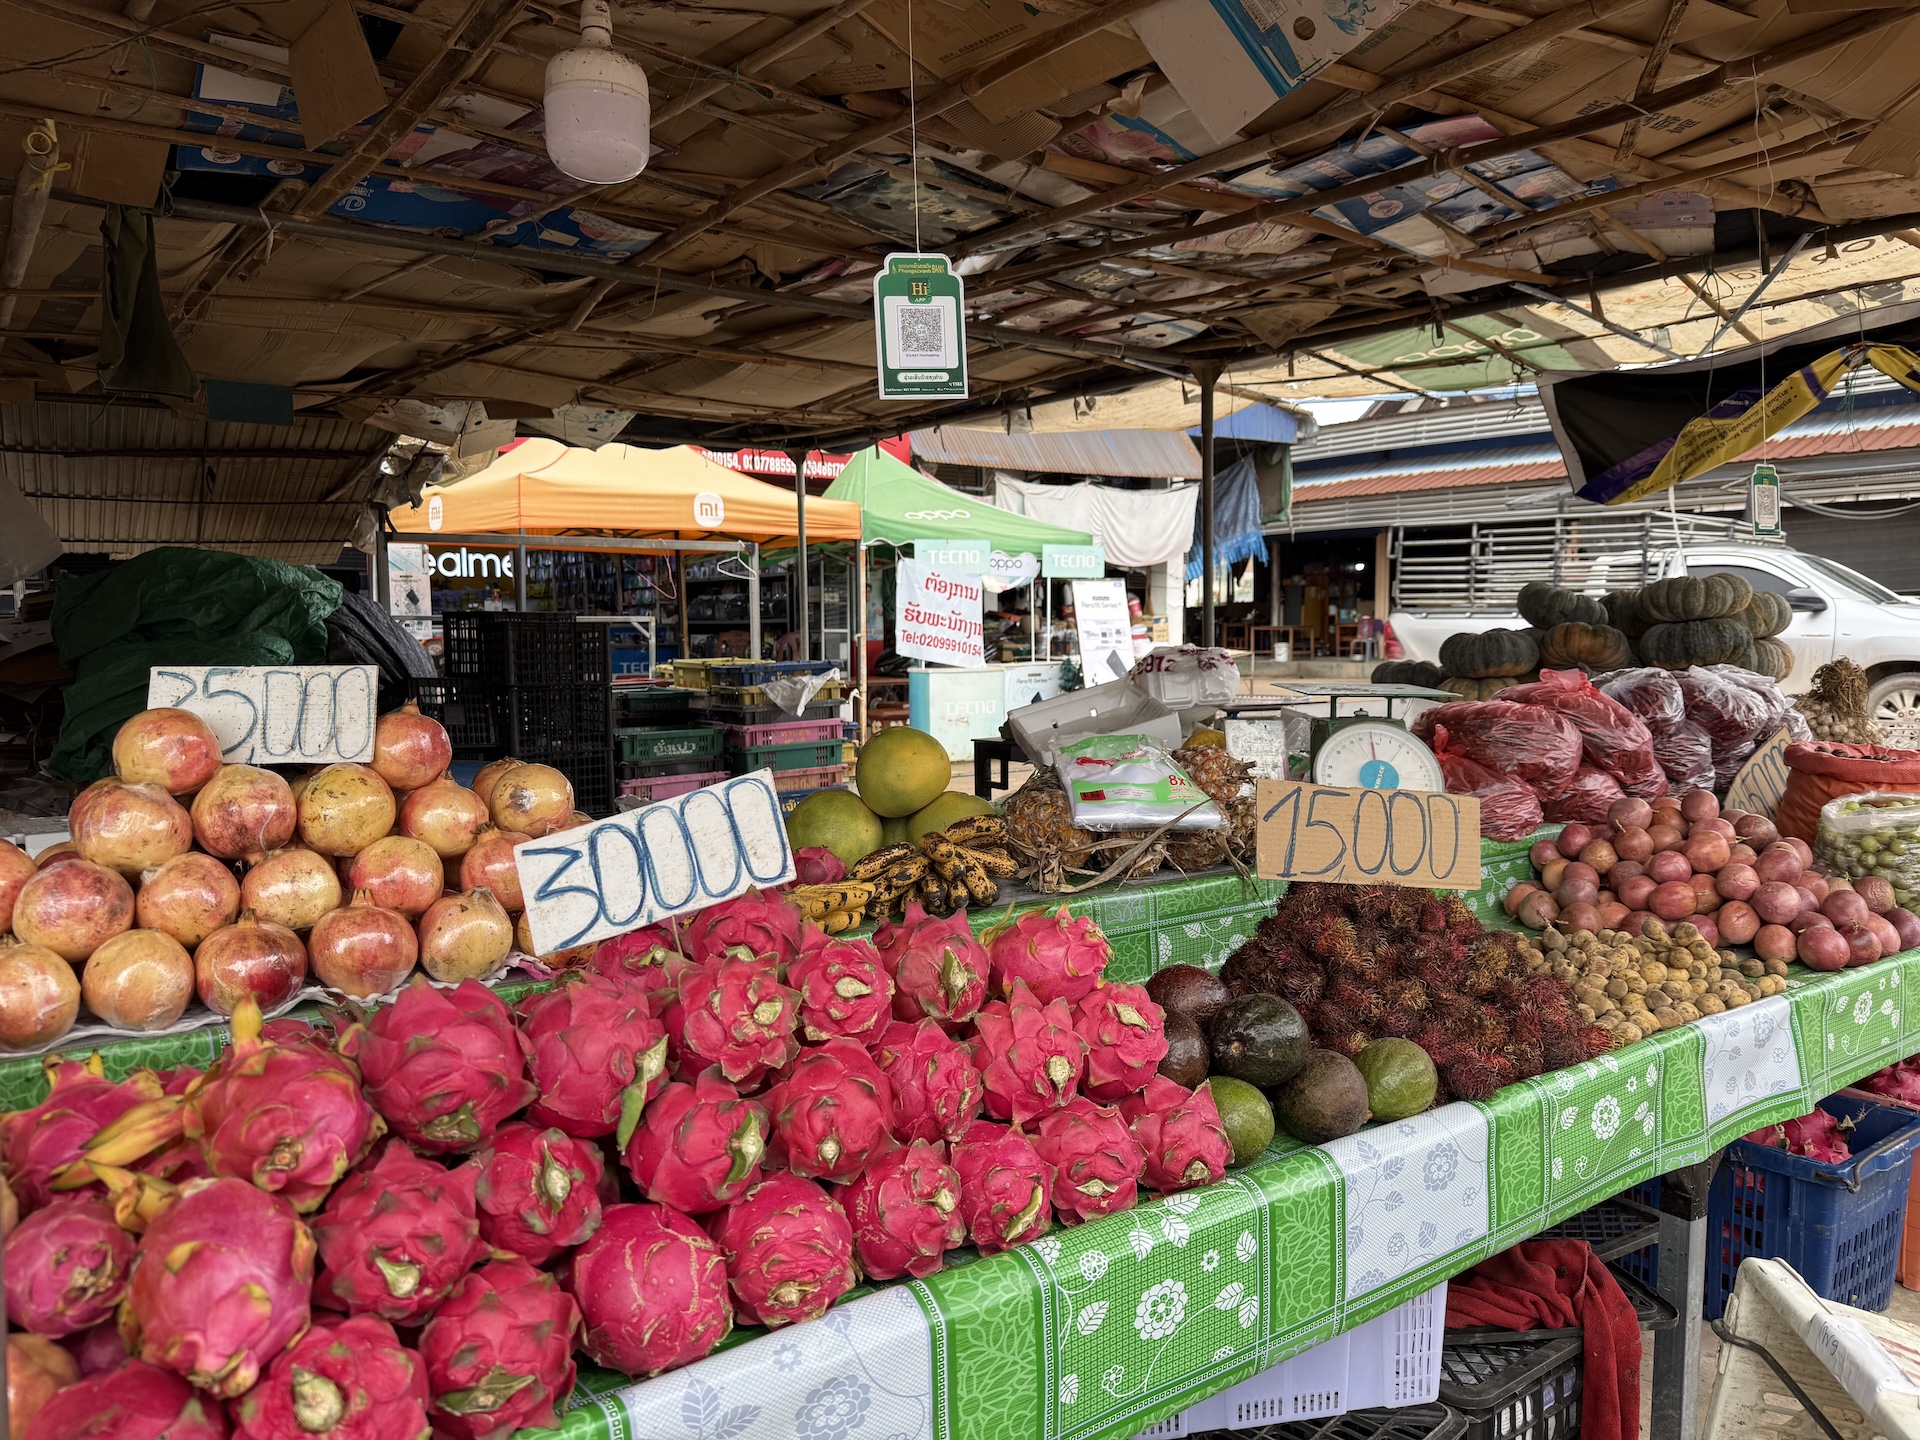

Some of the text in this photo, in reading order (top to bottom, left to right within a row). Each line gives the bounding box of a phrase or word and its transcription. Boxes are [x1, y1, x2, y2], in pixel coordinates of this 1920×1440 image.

[911, 282, 928, 296] Hi
[904, 508, 971, 521] oppo
[928, 550, 980, 565] TECNO
[990, 558, 1022, 570] oppo
[1052, 553, 1095, 569] TECNO
